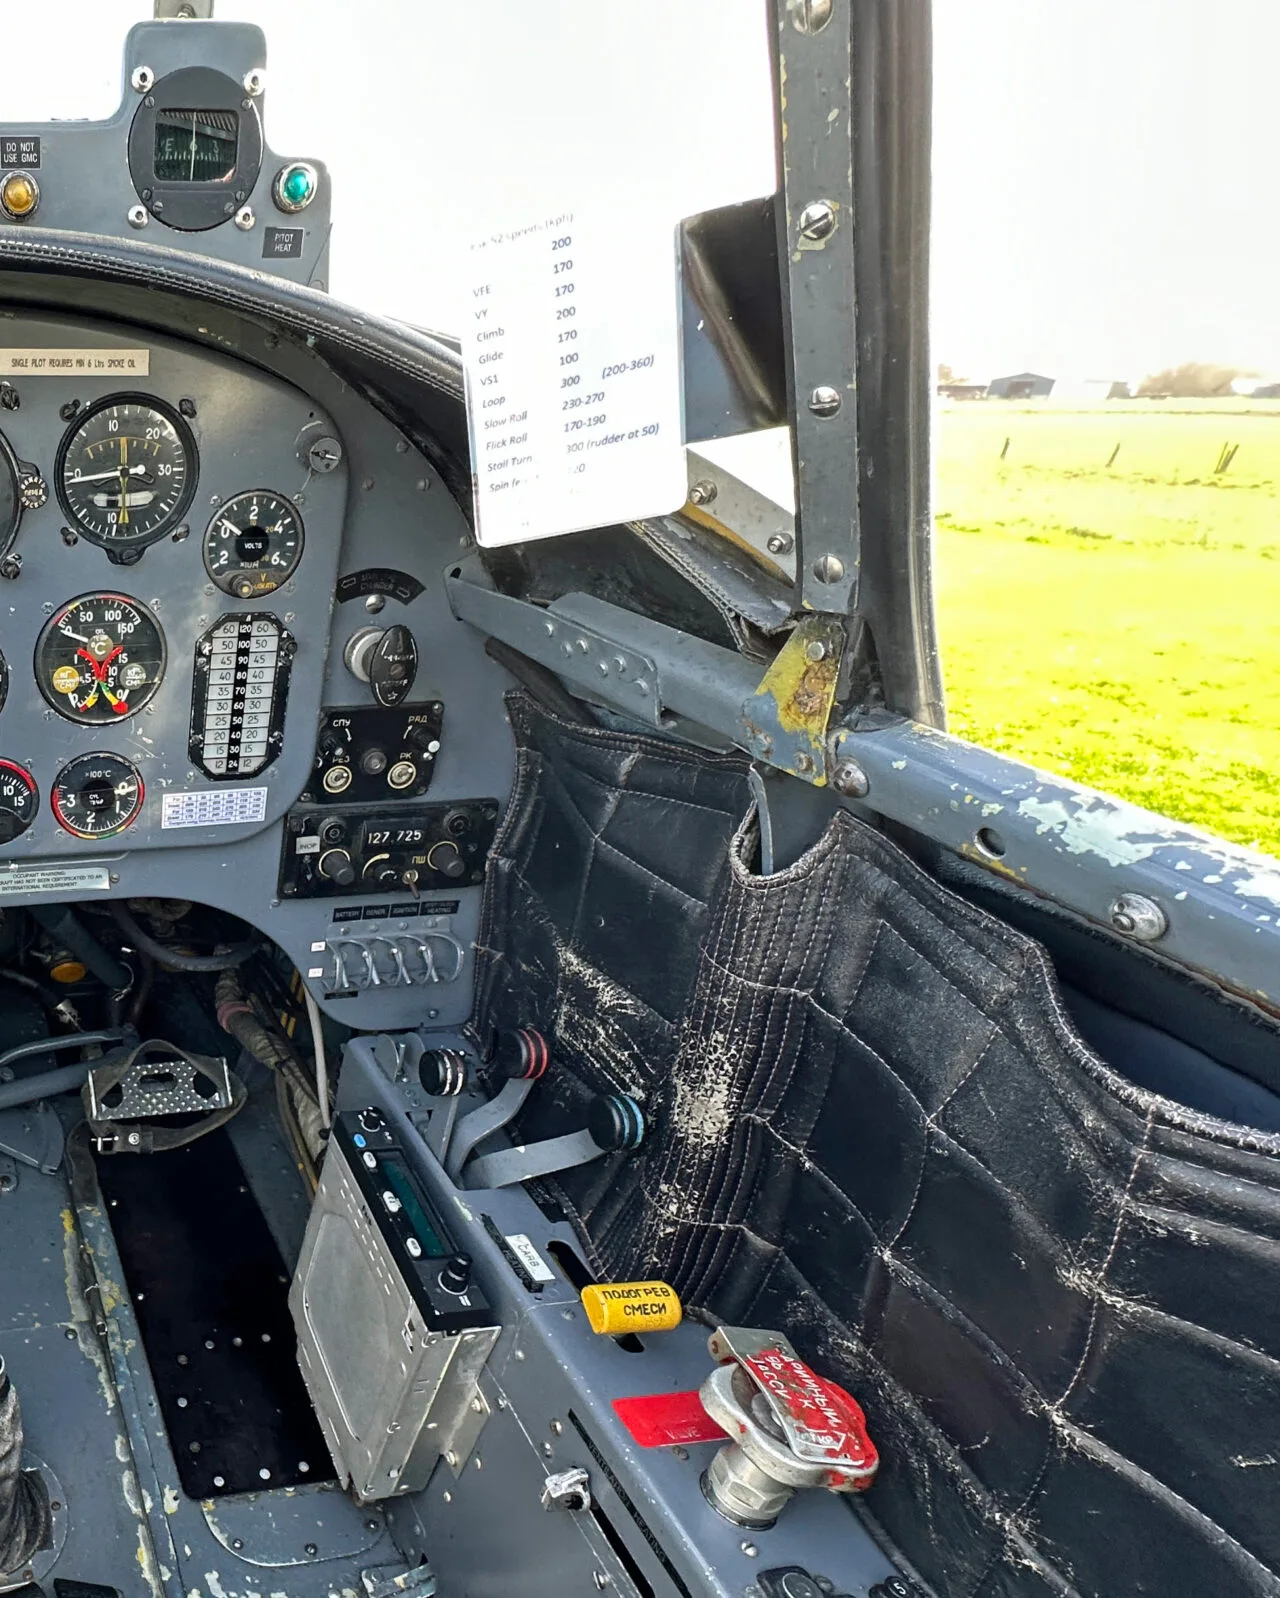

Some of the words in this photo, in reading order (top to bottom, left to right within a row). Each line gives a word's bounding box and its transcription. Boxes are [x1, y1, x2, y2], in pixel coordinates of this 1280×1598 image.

[6, 143, 16, 152] DO
[20, 143, 34, 152] NOT
[4, 153, 17, 162] USE
[21, 153, 37, 162] GMC
[275, 234, 293, 242] PITOT
[275, 243, 291, 252] HEAT
[551, 236, 571, 251] 200
[473, 285, 491, 298] VFE
[553, 260, 573, 274] 170
[475, 309, 488, 320] VY
[555, 283, 575, 298] 170
[477, 328, 504, 342] Climb
[556, 306, 576, 320] 200
[479, 351, 503, 365] Glide
[558, 329, 577, 343] 170
[12, 359, 28, 367] SINGLE
[32, 359, 45, 367] PILOT
[49, 359, 73, 367] REQUIRES
[76, 359, 84, 367] MIN
[95, 359, 104, 367] Ltrs
[108, 359, 124, 368] SMOKE
[128, 359, 136, 367] OIL
[480, 375, 498, 386] VS1
[559, 353, 579, 366] 100
[482, 396, 505, 409] Loop
[560, 374, 580, 389] 300
[602, 355, 654, 380] (200-360)
[484, 418, 507, 430] Slow
[510, 412, 527, 423] Roll
[562, 392, 605, 410] 230-270
[486, 438, 507, 450] Flick
[509, 434, 527, 445] Roll
[564, 414, 606, 432] 170-190
[488, 459, 509, 472] Stall
[512, 455, 532, 466] Turn
[587, 432, 625, 450] (rudder
[628, 430, 639, 439] at
[642, 422, 659, 436] 50)
[158, 465, 171, 475] 30
[489, 480, 509, 493] Spin
[80, 612, 93, 621] 50
[105, 611, 121, 620] 100
[223, 625, 235, 633] 60
[240, 625, 252, 633] 120
[257, 624, 269, 632] 60
[222, 641, 233, 650] 50
[238, 640, 250, 649] 100
[256, 640, 267, 649] 50
[220, 656, 232, 665] 45
[238, 656, 248, 664] 90
[254, 655, 265, 663] 45
[219, 672, 231, 681] 40
[237, 671, 247, 679] 80
[252, 670, 264, 679] 40
[218, 687, 229, 696] 35
[235, 687, 245, 695] 70
[251, 686, 262, 695] 35
[217, 702, 228, 711] 30
[234, 702, 244, 710] 60
[249, 701, 261, 710] 30
[215, 717, 227, 726] 25
[247, 716, 259, 724] 25
[333, 719, 351, 727] СПУ
[214, 731, 226, 740] 20
[231, 732, 241, 740] 40
[216, 745, 224, 754] 15
[230, 746, 240, 754] 30
[245, 745, 252, 753] 15
[215, 760, 223, 769] 12
[228, 760, 238, 768] 24
[243, 759, 251, 767] 12
[520, 1244, 540, 1267] CARB
[602, 1288, 670, 1300] ПОДОГРЕВ
[623, 1303, 666, 1316] СМЕСИ
